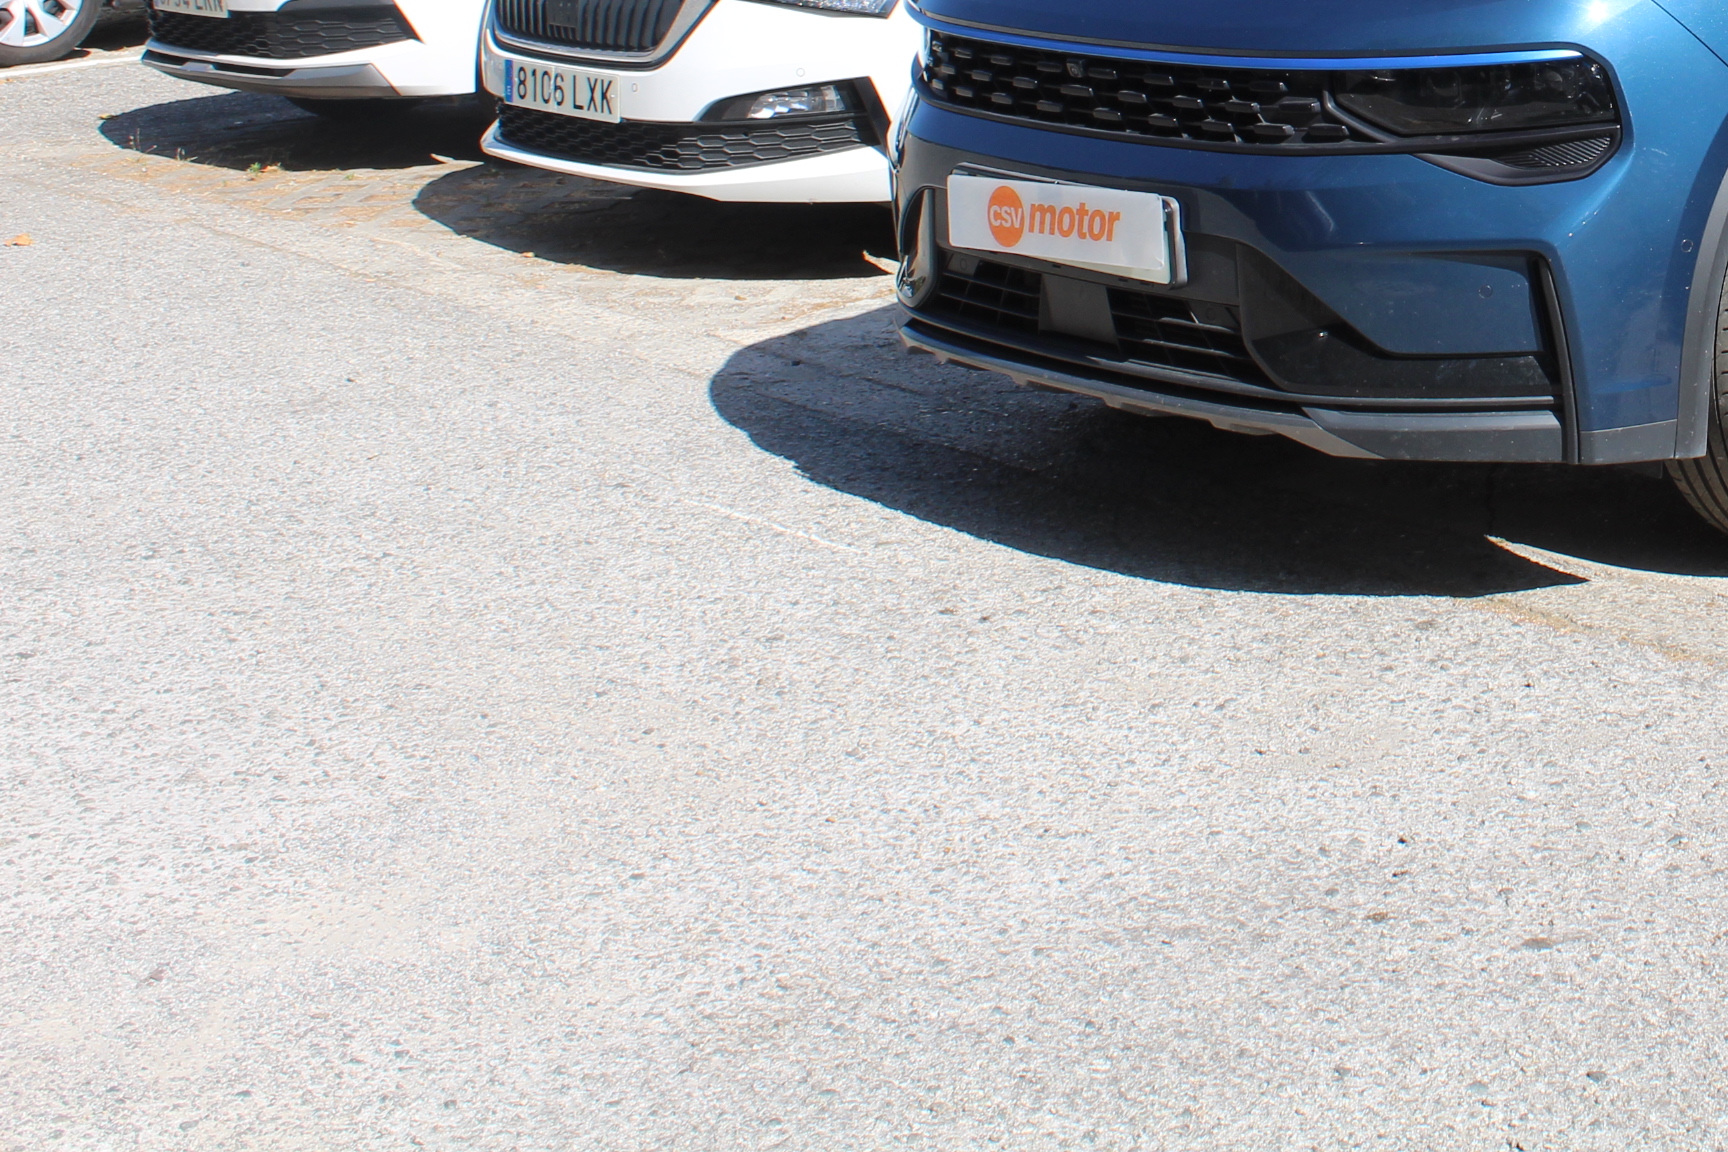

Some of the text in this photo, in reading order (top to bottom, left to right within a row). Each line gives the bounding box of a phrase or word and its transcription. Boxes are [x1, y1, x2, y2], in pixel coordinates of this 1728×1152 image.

[517, 66, 565, 106] 8106
[572, 74, 612, 115] LXK
[1028, 202, 1121, 242] motor
